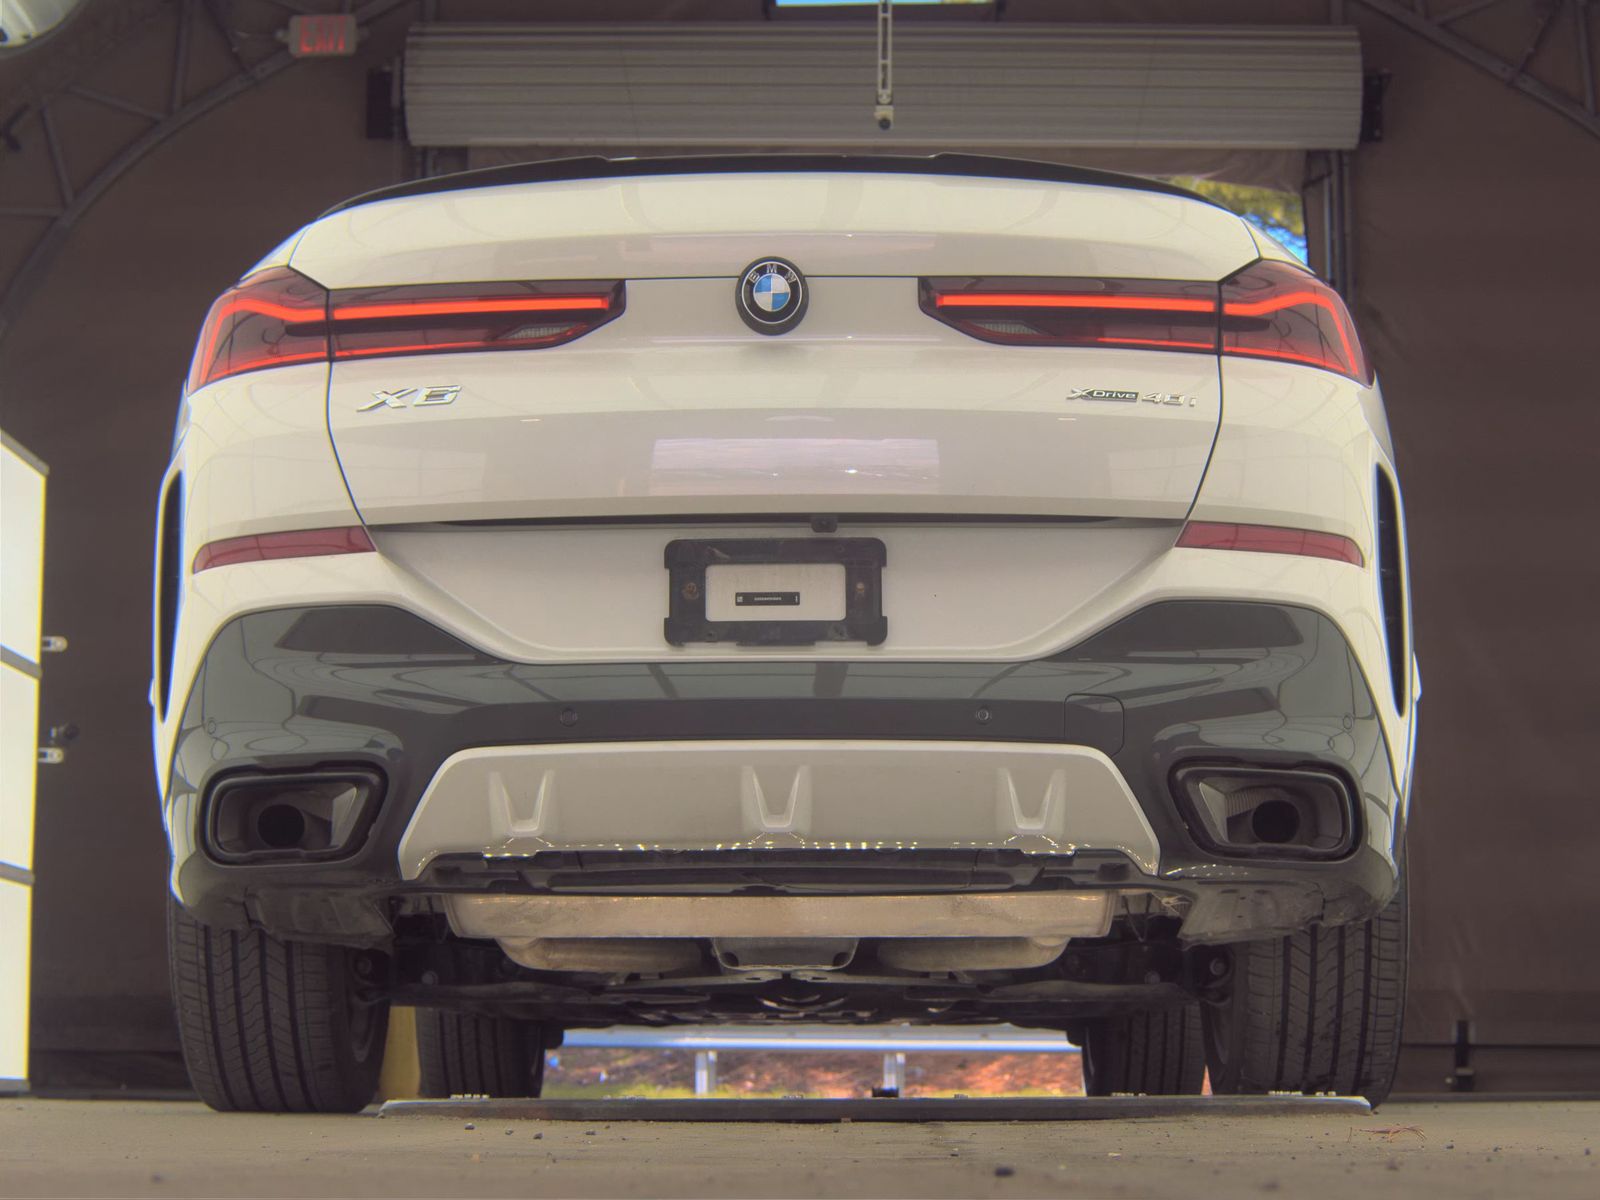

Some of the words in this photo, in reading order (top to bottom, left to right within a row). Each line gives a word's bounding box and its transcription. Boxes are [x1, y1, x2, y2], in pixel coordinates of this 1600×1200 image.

[300, 16, 346, 52] EXIT
[748, 263, 797, 284] BMW
[356, 384, 462, 412] X6
